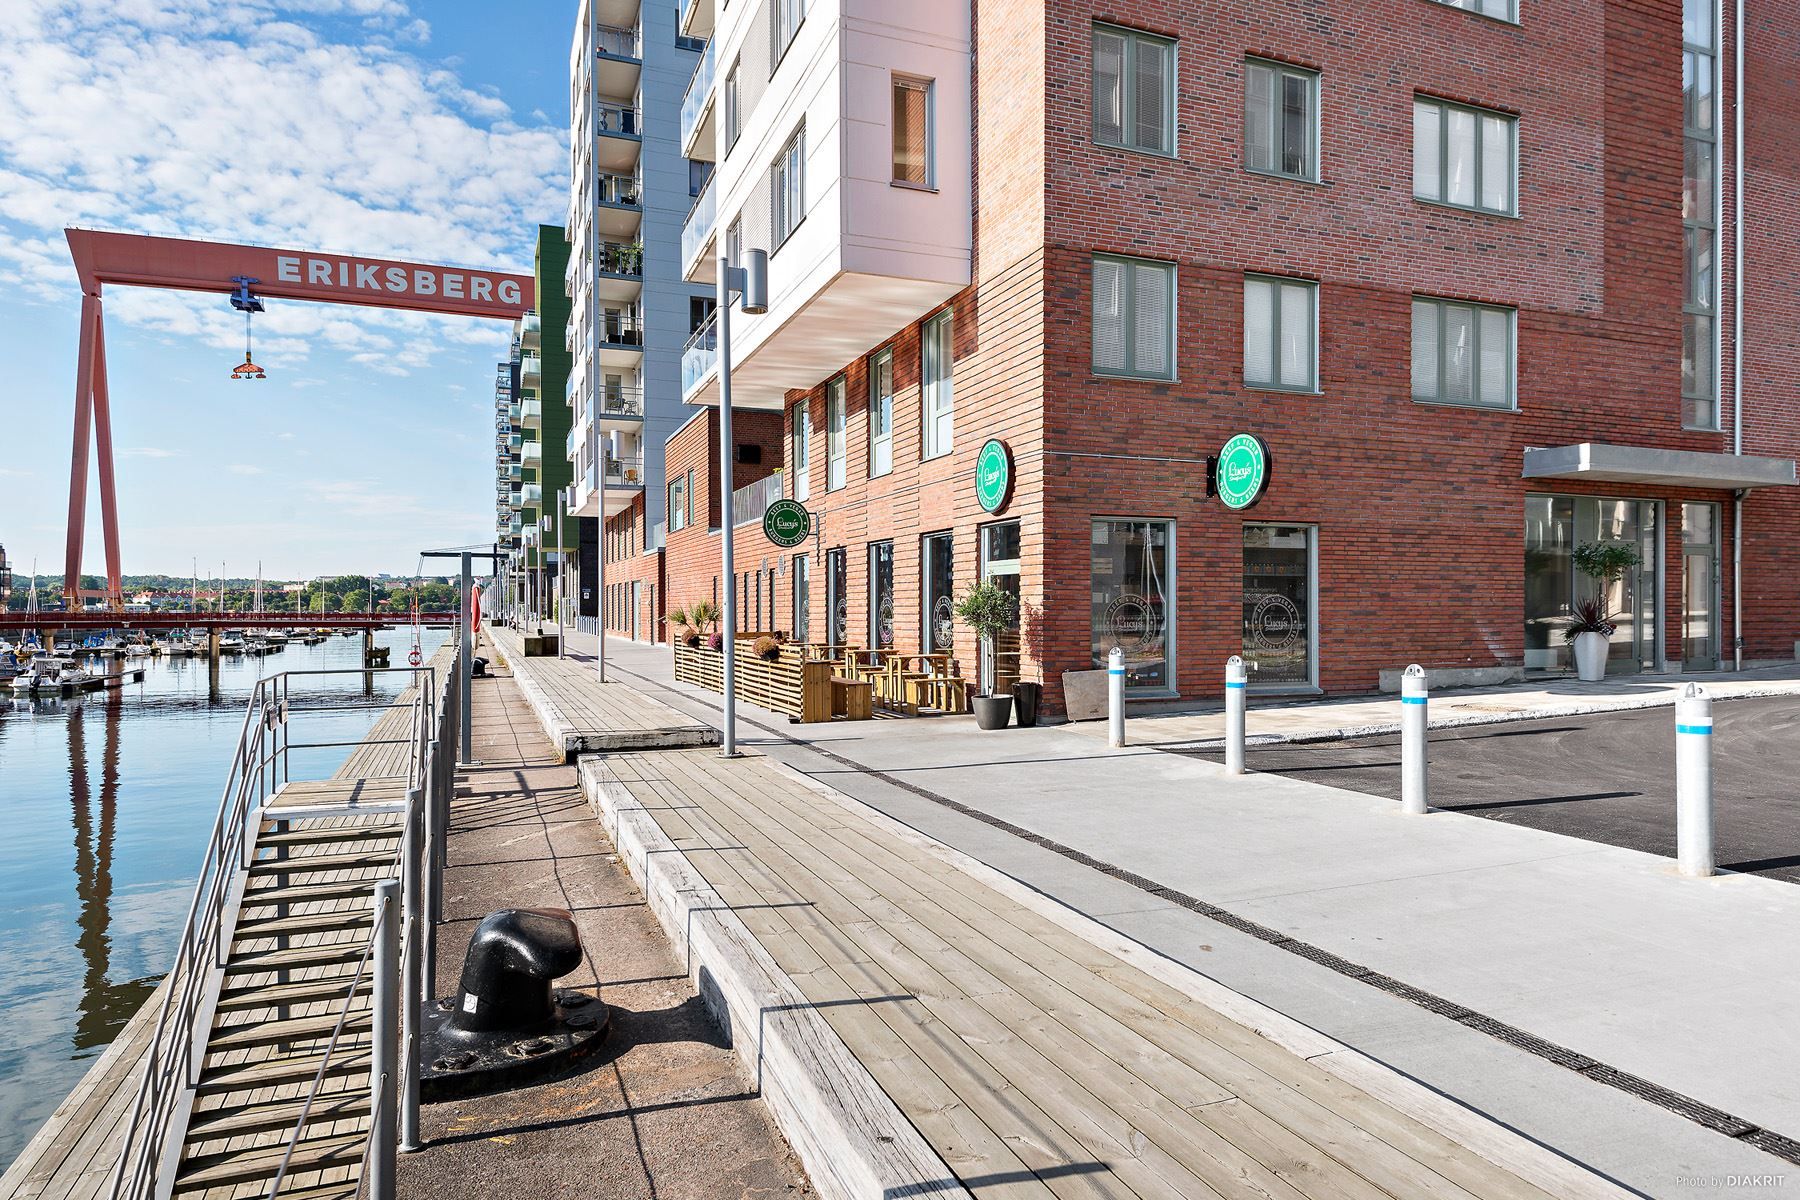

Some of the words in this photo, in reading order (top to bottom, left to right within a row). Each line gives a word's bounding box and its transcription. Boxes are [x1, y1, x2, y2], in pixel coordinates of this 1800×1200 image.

[277, 255, 521, 305] ERIKSBERG
[1222, 443, 1235, 460] BEEF
[1242, 439, 1260, 456] VEGAN
[1228, 461, 1252, 479] Lucy's
[1219, 481, 1238, 504] BURGERS
[1246, 477, 1260, 500] BEERS
[770, 504, 782, 515] BEEF
[789, 504, 804, 516] VEGAN
[776, 516, 799, 529] Lucy's
[769, 528, 788, 544] BURGERS
[794, 529, 806, 543] BEERS
[1116, 614, 1143, 631] Lucy's
[1264, 615, 1288, 630] Lucy's
